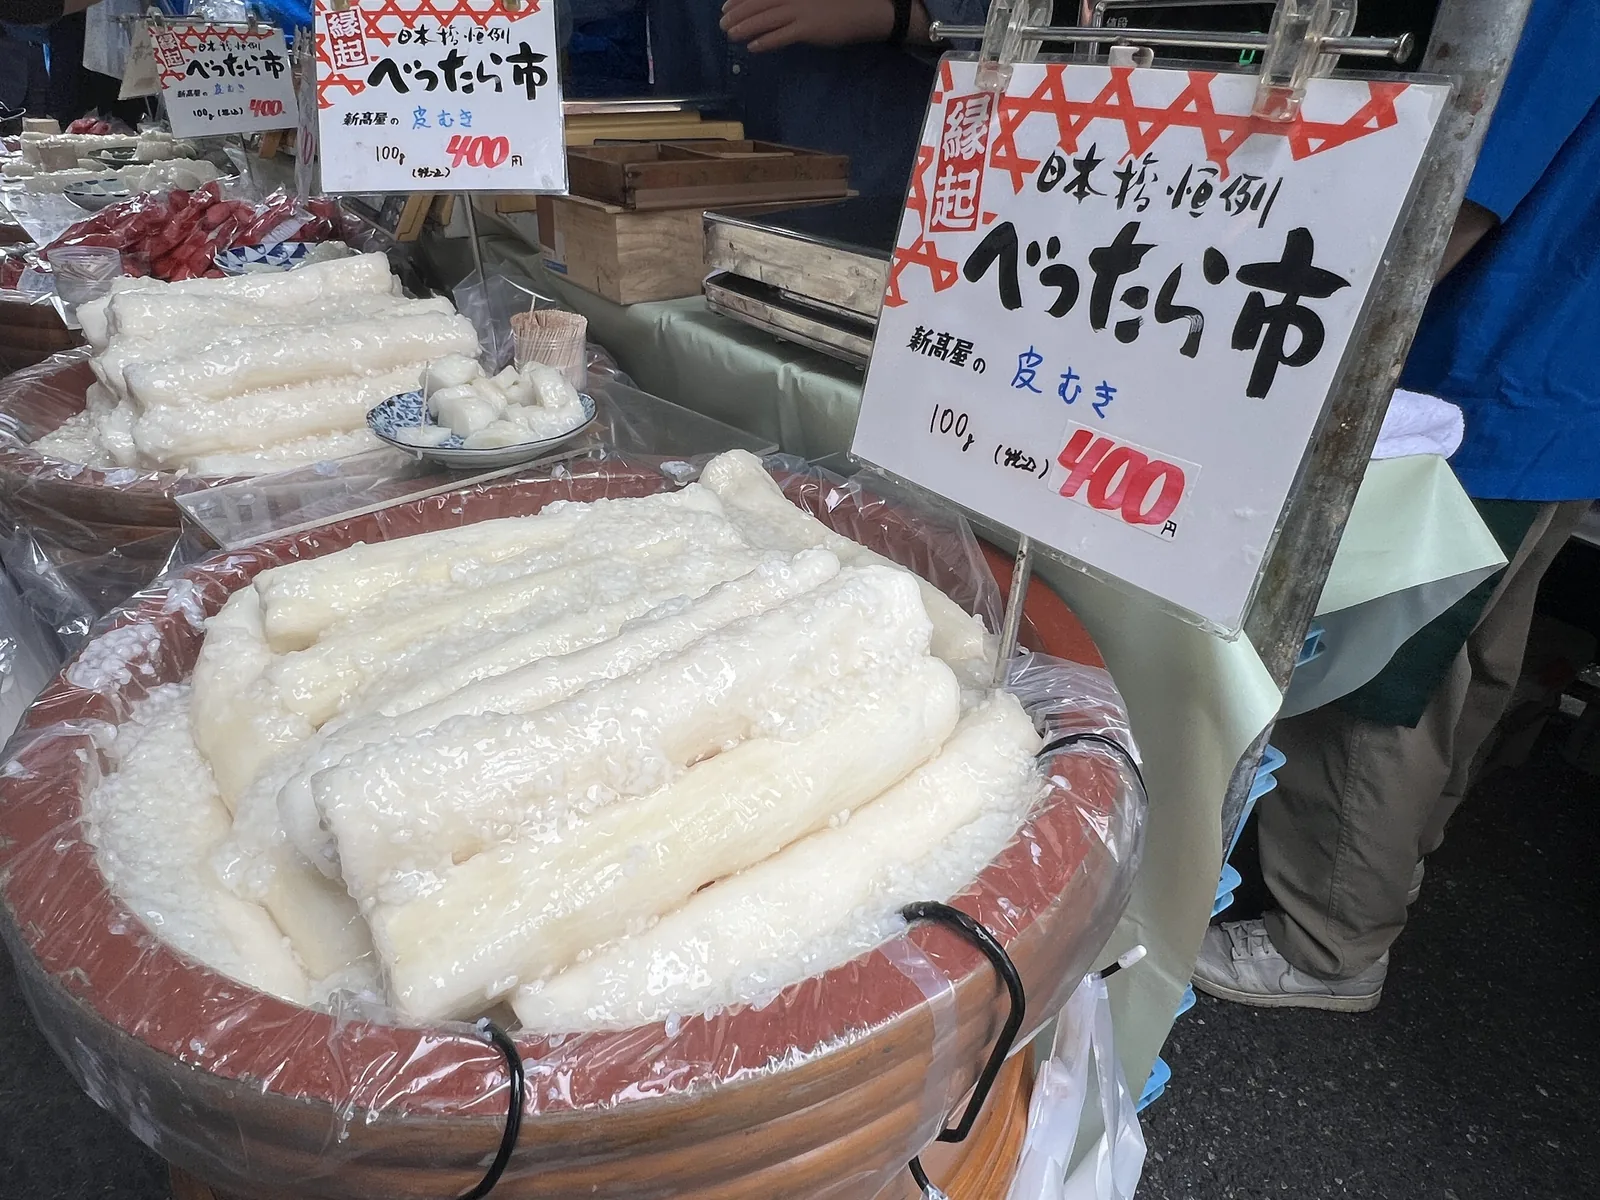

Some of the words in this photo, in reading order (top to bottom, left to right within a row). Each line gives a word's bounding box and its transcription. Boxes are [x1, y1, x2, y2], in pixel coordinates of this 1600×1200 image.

[186, 50, 285, 79] べったら市
[325, 11, 366, 68] 縁起
[397, 24, 510, 47] 日本橋恒例
[367, 42, 549, 100] べったら市
[412, 105, 473, 130] 皮むき
[930, 94, 991, 228] 縁起
[1036, 142, 1285, 228] 日本橋恒例
[963, 221, 1351, 399] べったら市
[1010, 345, 1118, 419] 皮むき
